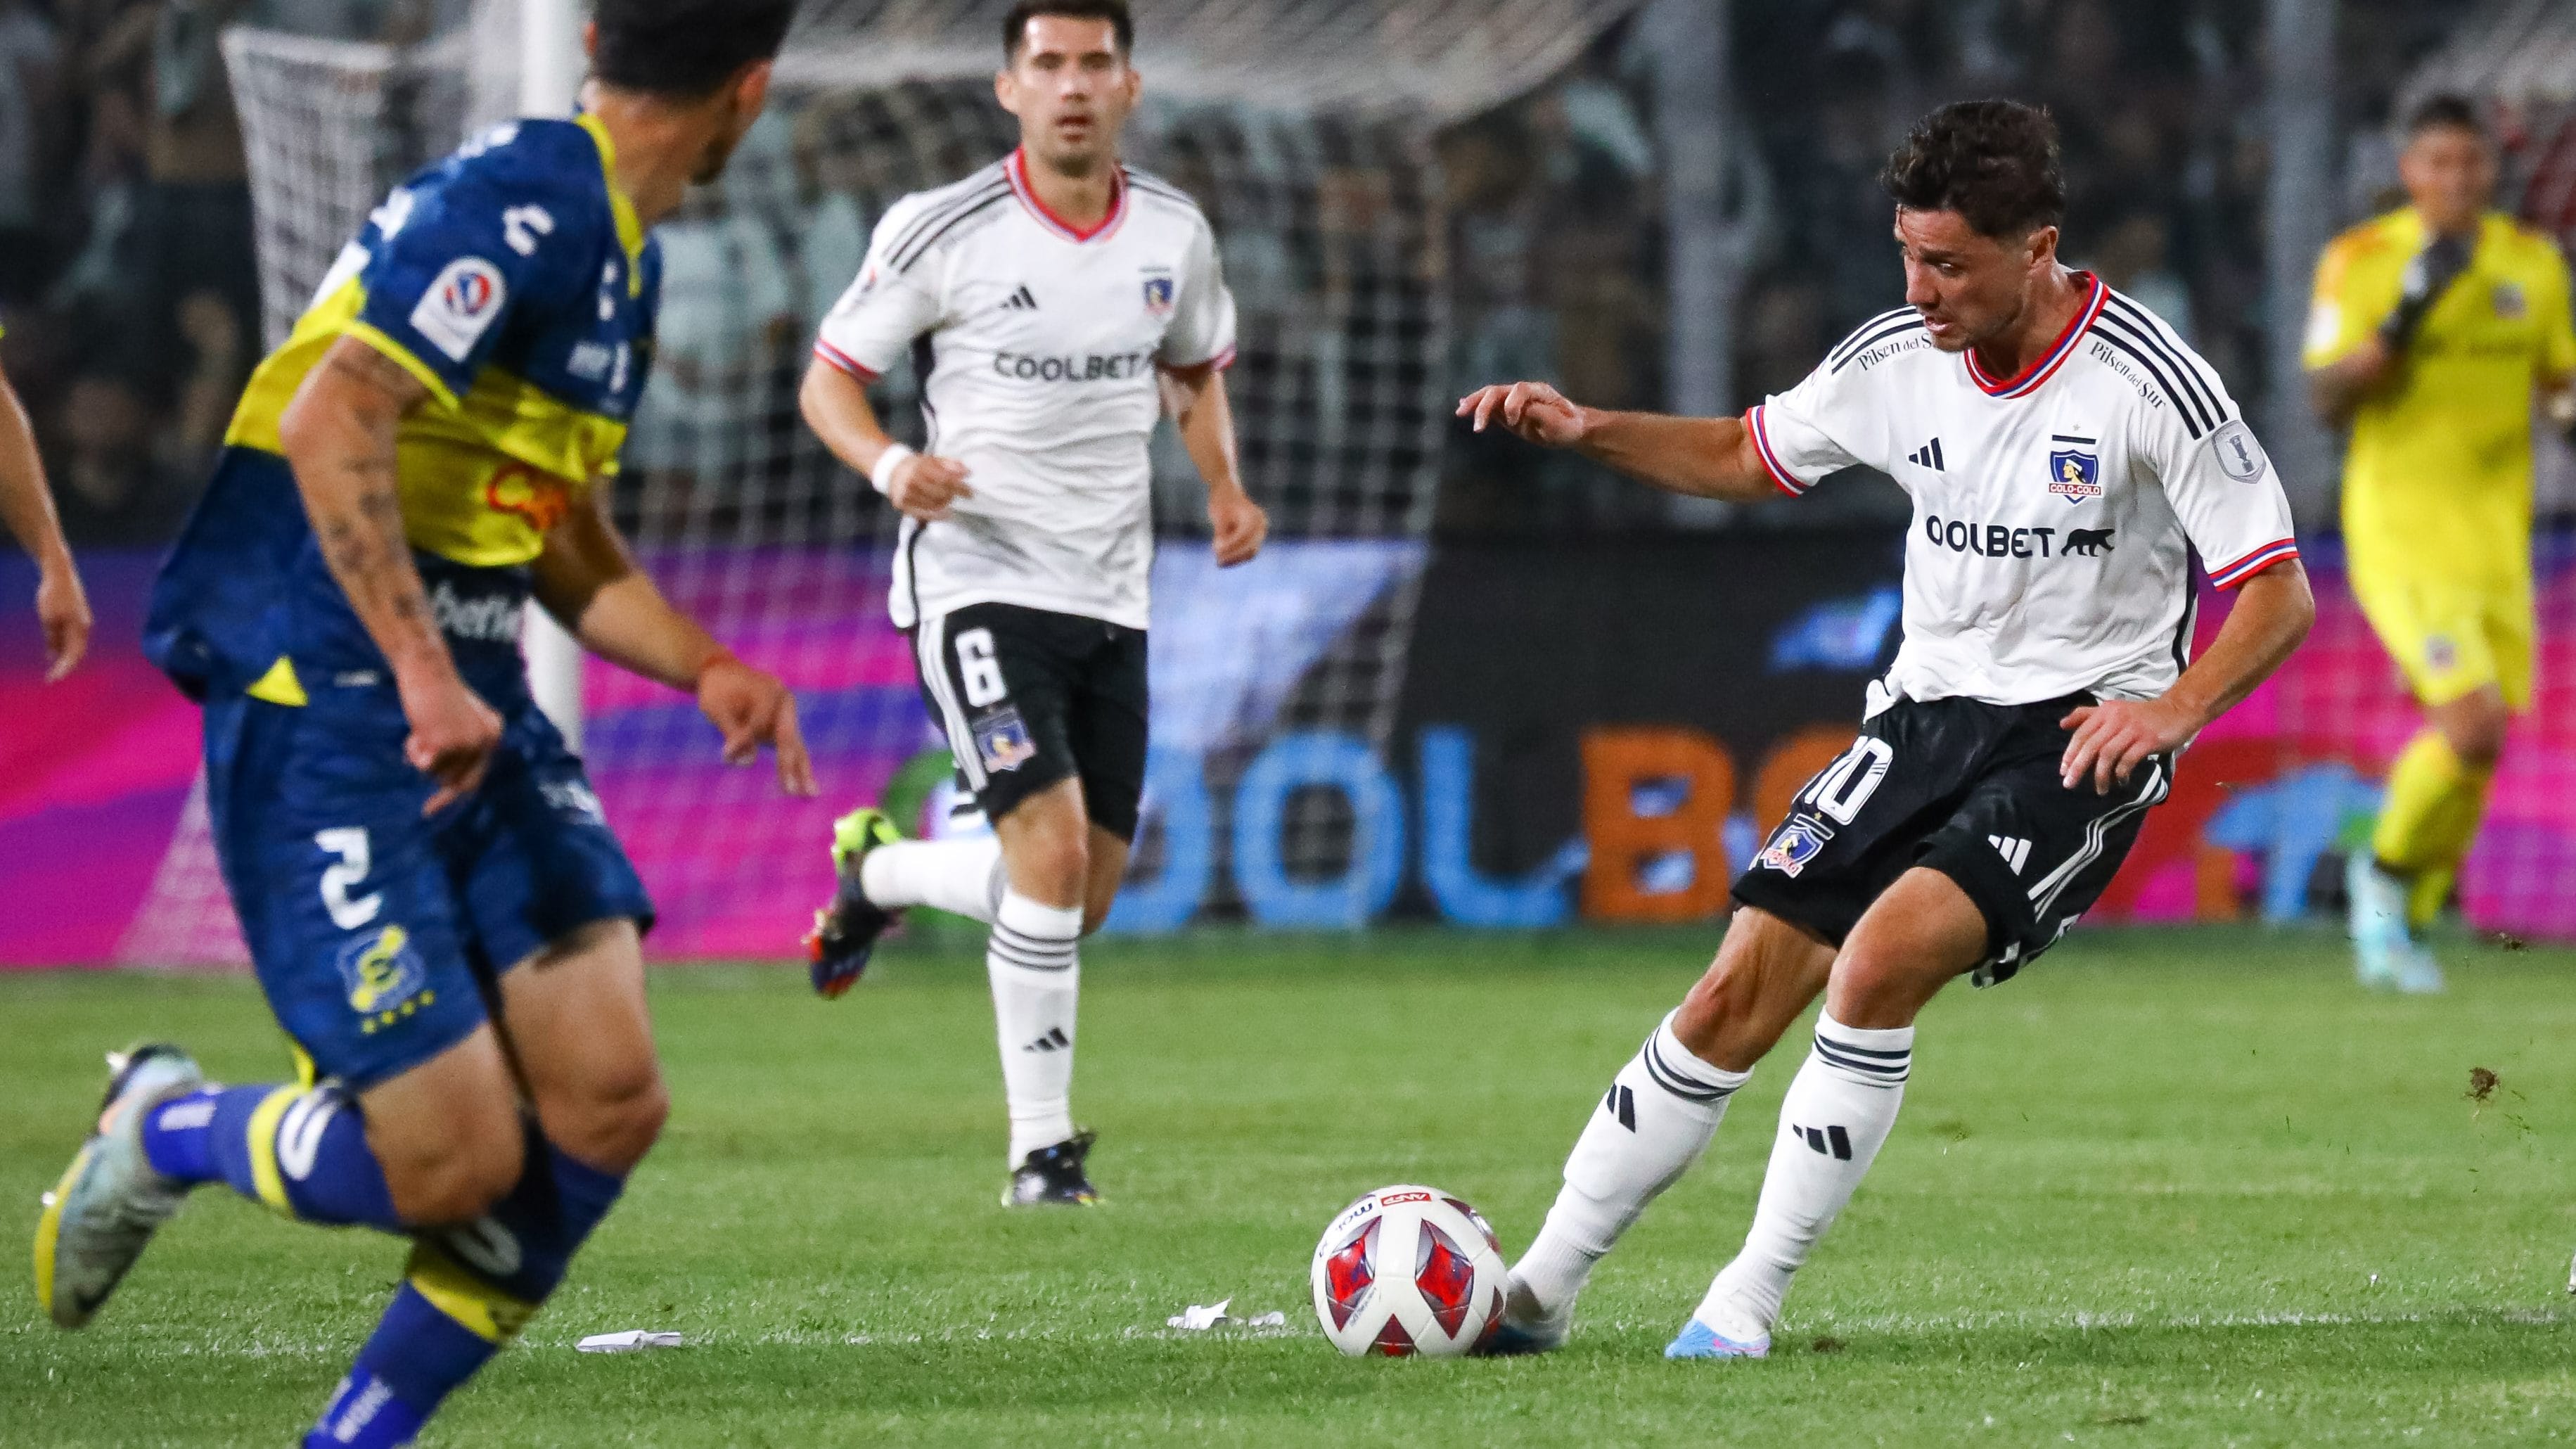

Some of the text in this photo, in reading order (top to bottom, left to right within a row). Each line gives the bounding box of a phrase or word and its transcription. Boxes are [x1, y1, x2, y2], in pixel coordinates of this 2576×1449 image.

[1858, 342, 1901, 371] Pilsen
[1903, 338, 1919, 351] del
[2089, 341, 2166, 409] Pilsen del Sur
[2049, 483, 2101, 495] COLO-COLO
[1925, 515, 2056, 558] OOLBET
[955, 625, 1008, 708] 6
[1804, 736, 1894, 826] 10
[314, 826, 384, 930] 2
